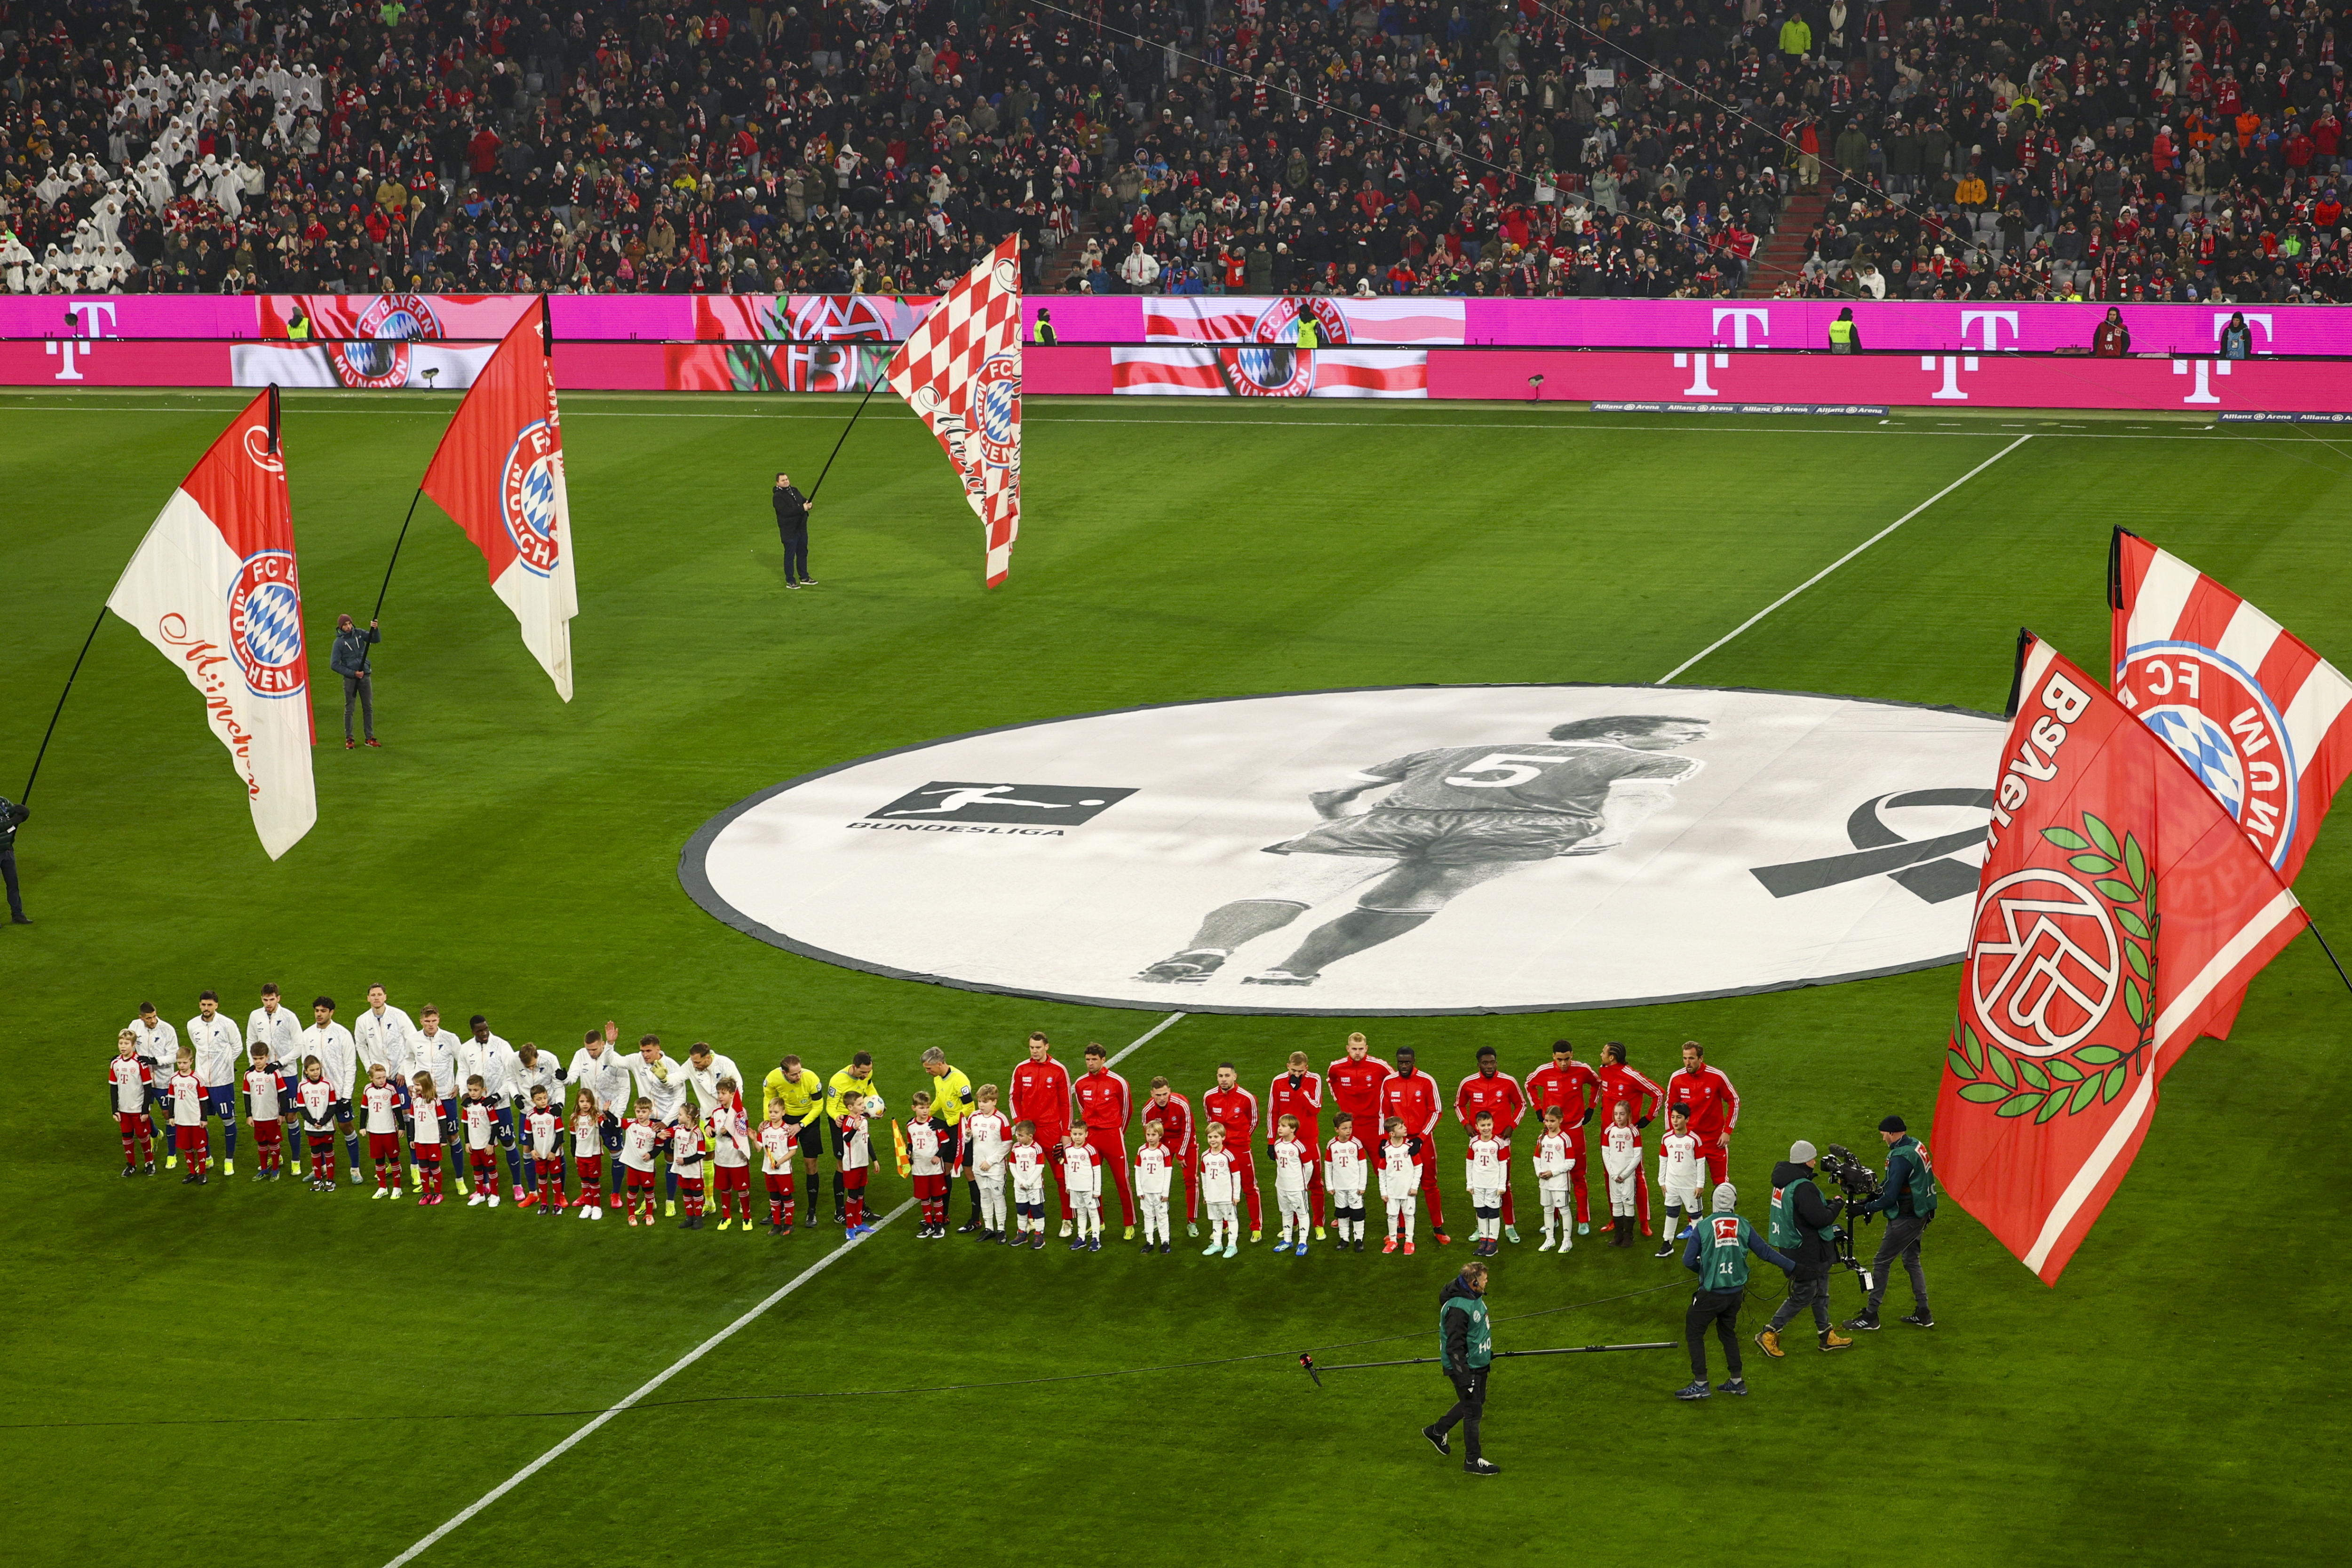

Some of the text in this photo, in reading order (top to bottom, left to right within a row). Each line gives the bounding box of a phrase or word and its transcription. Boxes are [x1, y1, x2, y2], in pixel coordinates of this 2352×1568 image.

[362, 295, 434, 334] FC BAYERN
[1260, 316, 1281, 340] FC
[334, 354, 408, 388] MÜNCHEN
[989, 361, 1011, 378] FC
[1226, 363, 1311, 397] MÜNCHEN
[252, 558, 278, 582] FC
[232, 588, 294, 689] MÜHEN
[1444, 753, 1575, 788] 5
[846, 822, 1065, 836] BUNDESLIGA
[120, 1074, 128, 1084] T
[178, 1090, 185, 1099] T
[256, 1085, 264, 1095] T
[311, 1097, 319, 1107] T
[373, 1102, 381, 1112] T
[220, 1102, 228, 1114] 11
[419, 1111, 426, 1122] T
[447, 1120, 456, 1131] 21
[471, 1118, 479, 1128] T
[499, 1124, 511, 1137] 34
[537, 1128, 545, 1137] T
[579, 1128, 588, 1138] T
[978, 1130, 987, 1141] T
[611, 1136, 617, 1147] 3
[636, 1138, 645, 1149] T
[917, 1138, 925, 1149] T
[1616, 1141, 1625, 1152] T
[679, 1144, 687, 1154] T
[769, 1142, 777, 1153] T
[1339, 1156, 1348, 1167] T
[1480, 1155, 1489, 1166] T
[1545, 1151, 1553, 1162] T
[1675, 1151, 1684, 1162] T
[1020, 1161, 1029, 1171] T
[1072, 1162, 1080, 1172] T
[1280, 1157, 1287, 1168] T
[1393, 1160, 1402, 1171] T
[1147, 1163, 1156, 1174] T
[1210, 1169, 1218, 1179] T
